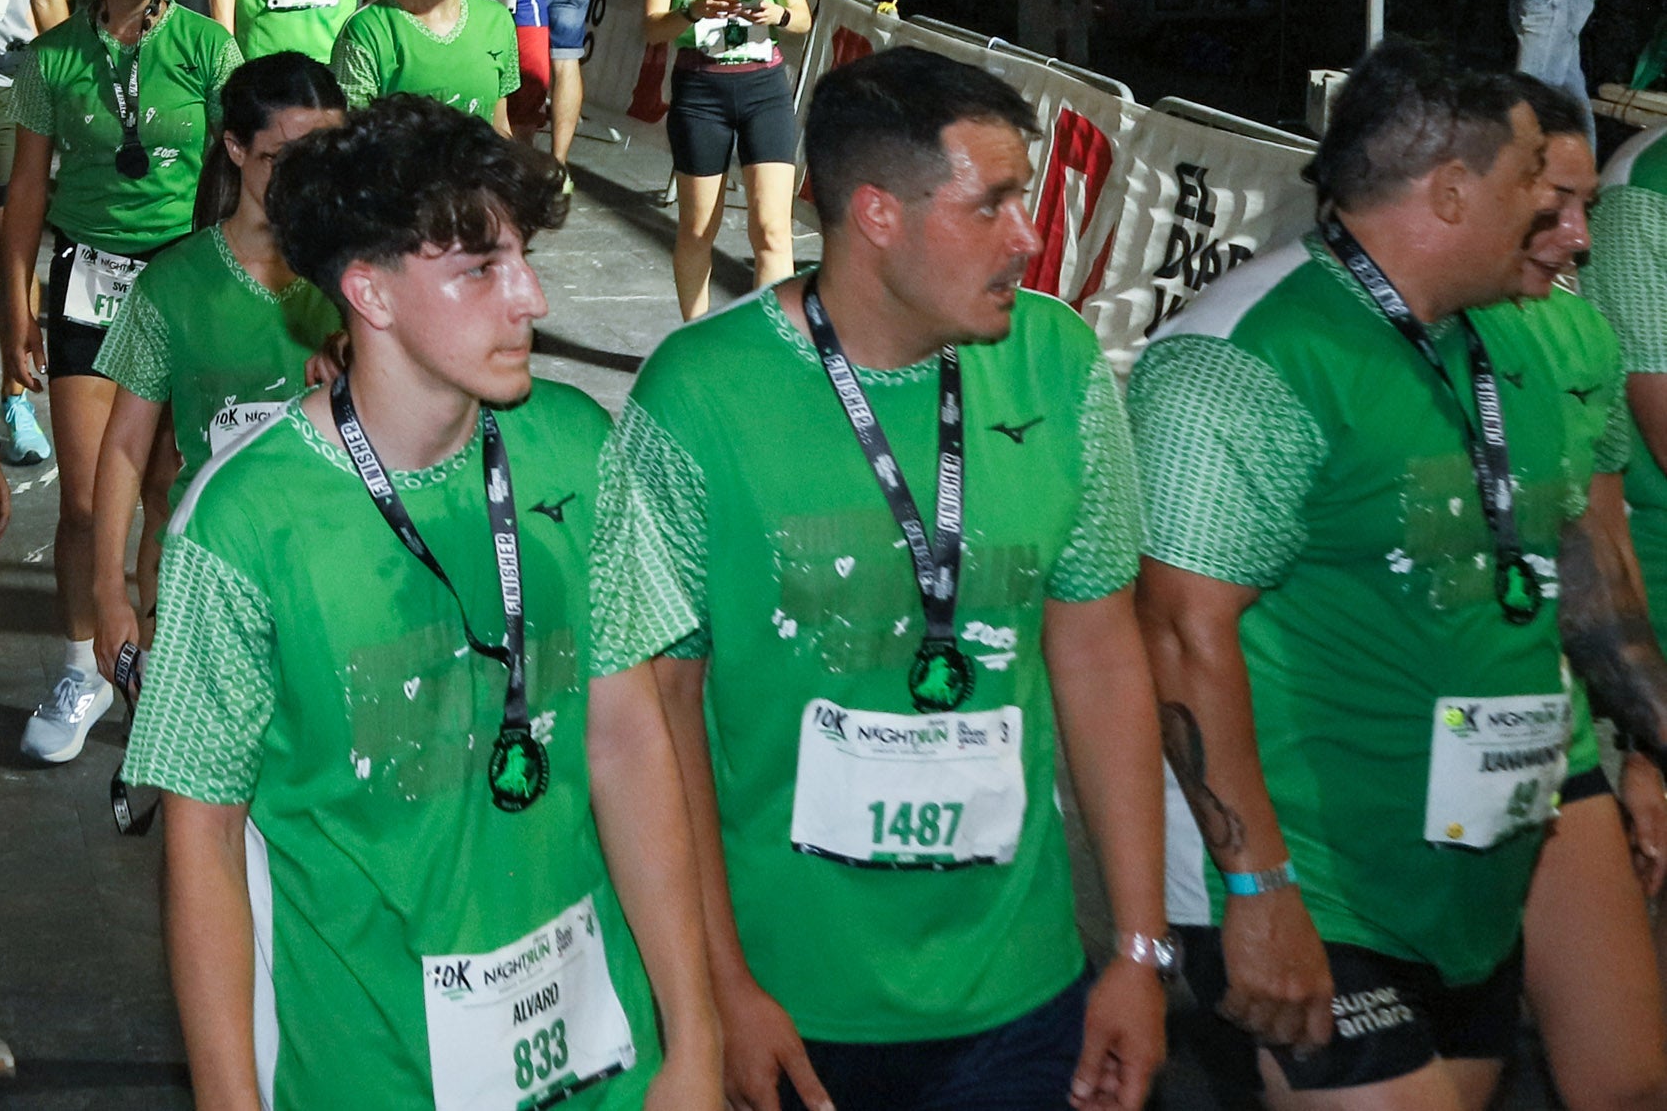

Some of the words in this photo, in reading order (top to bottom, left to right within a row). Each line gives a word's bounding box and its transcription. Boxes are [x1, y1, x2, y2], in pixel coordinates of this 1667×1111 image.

[1175, 161, 1215, 228] EL
[215, 407, 239, 426] 10K
[824, 353, 875, 429] FINISHER
[340, 421, 392, 498] FINISHER
[937, 452, 962, 534] FINISHER
[494, 532, 522, 616] FINISHER
[814, 705, 849, 740] 10K
[868, 801, 964, 847] 1487
[513, 982, 560, 1026] ALVARO
[513, 1018, 569, 1090] 833
